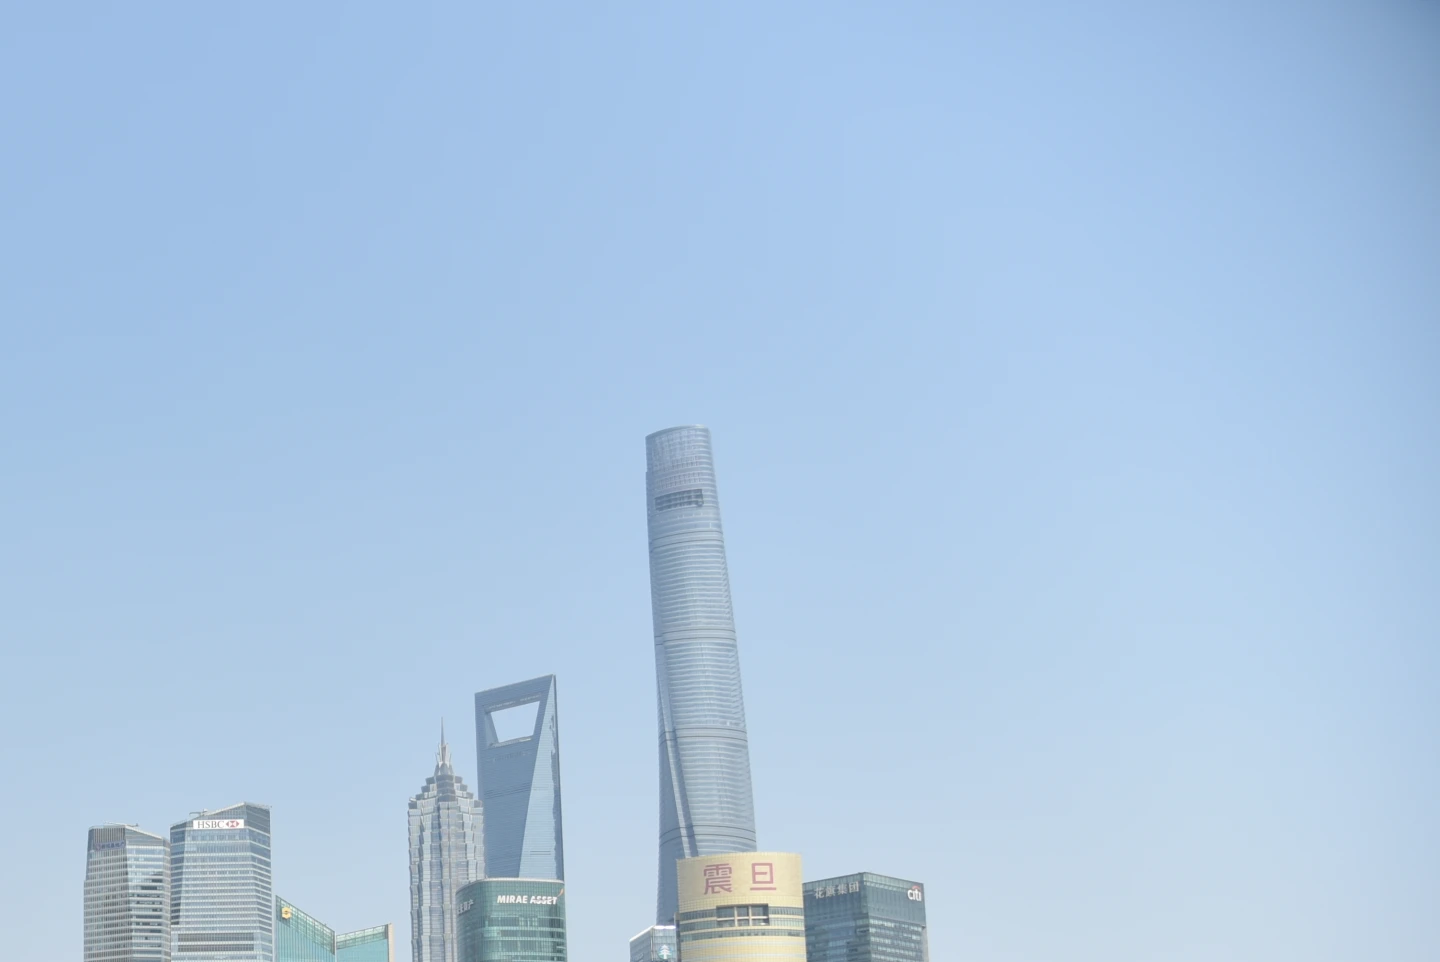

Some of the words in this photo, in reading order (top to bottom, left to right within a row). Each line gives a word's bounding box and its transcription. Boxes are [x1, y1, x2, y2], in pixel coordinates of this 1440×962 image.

[197, 820, 225, 829] HSBC
[703, 863, 777, 895] 震旦
[814, 881, 860, 899] 花旗集团
[907, 886, 922, 901] citi
[497, 895, 528, 904] MIRAE
[530, 896, 558, 905] ASSET
